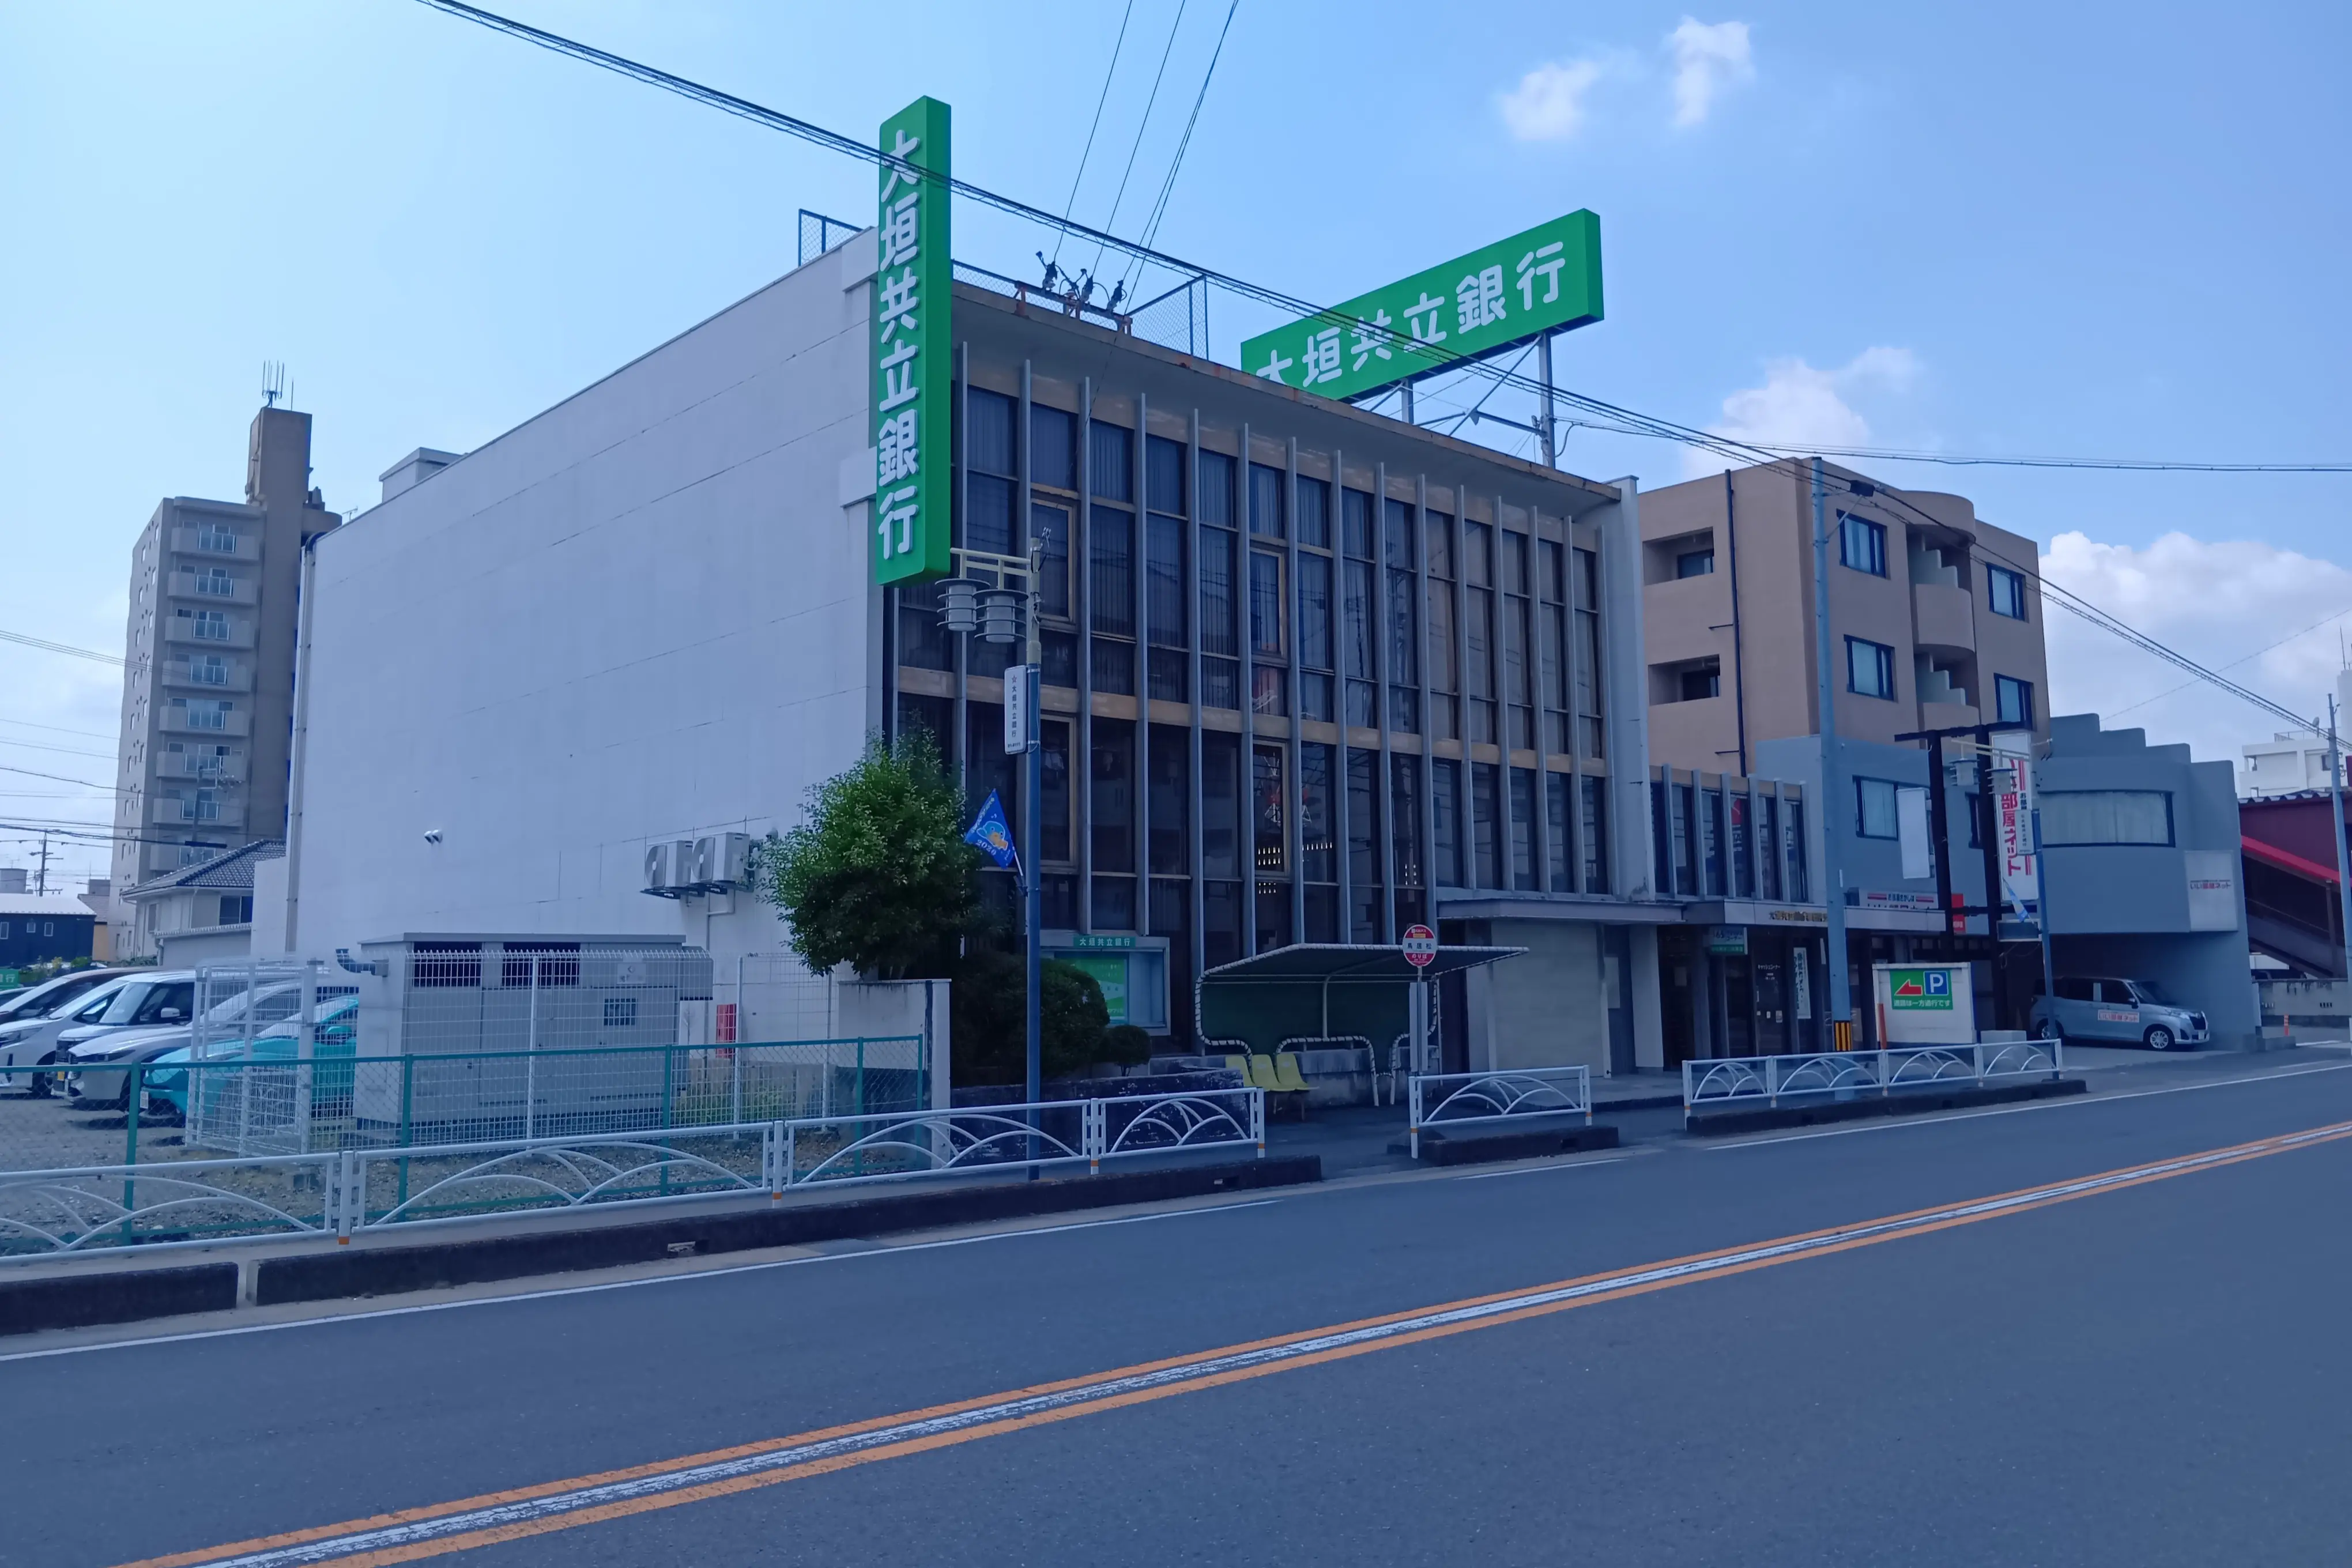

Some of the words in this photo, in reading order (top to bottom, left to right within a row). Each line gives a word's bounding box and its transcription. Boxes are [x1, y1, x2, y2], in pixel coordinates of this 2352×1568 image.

[1256, 241, 1566, 387] 大垣共立銀行
[878, 129, 921, 560] 大垣共立銀行
[975, 839, 997, 855] 2020
[1079, 937, 1130, 947] 大垣共立銀行
[1929, 973, 1944, 993] P
